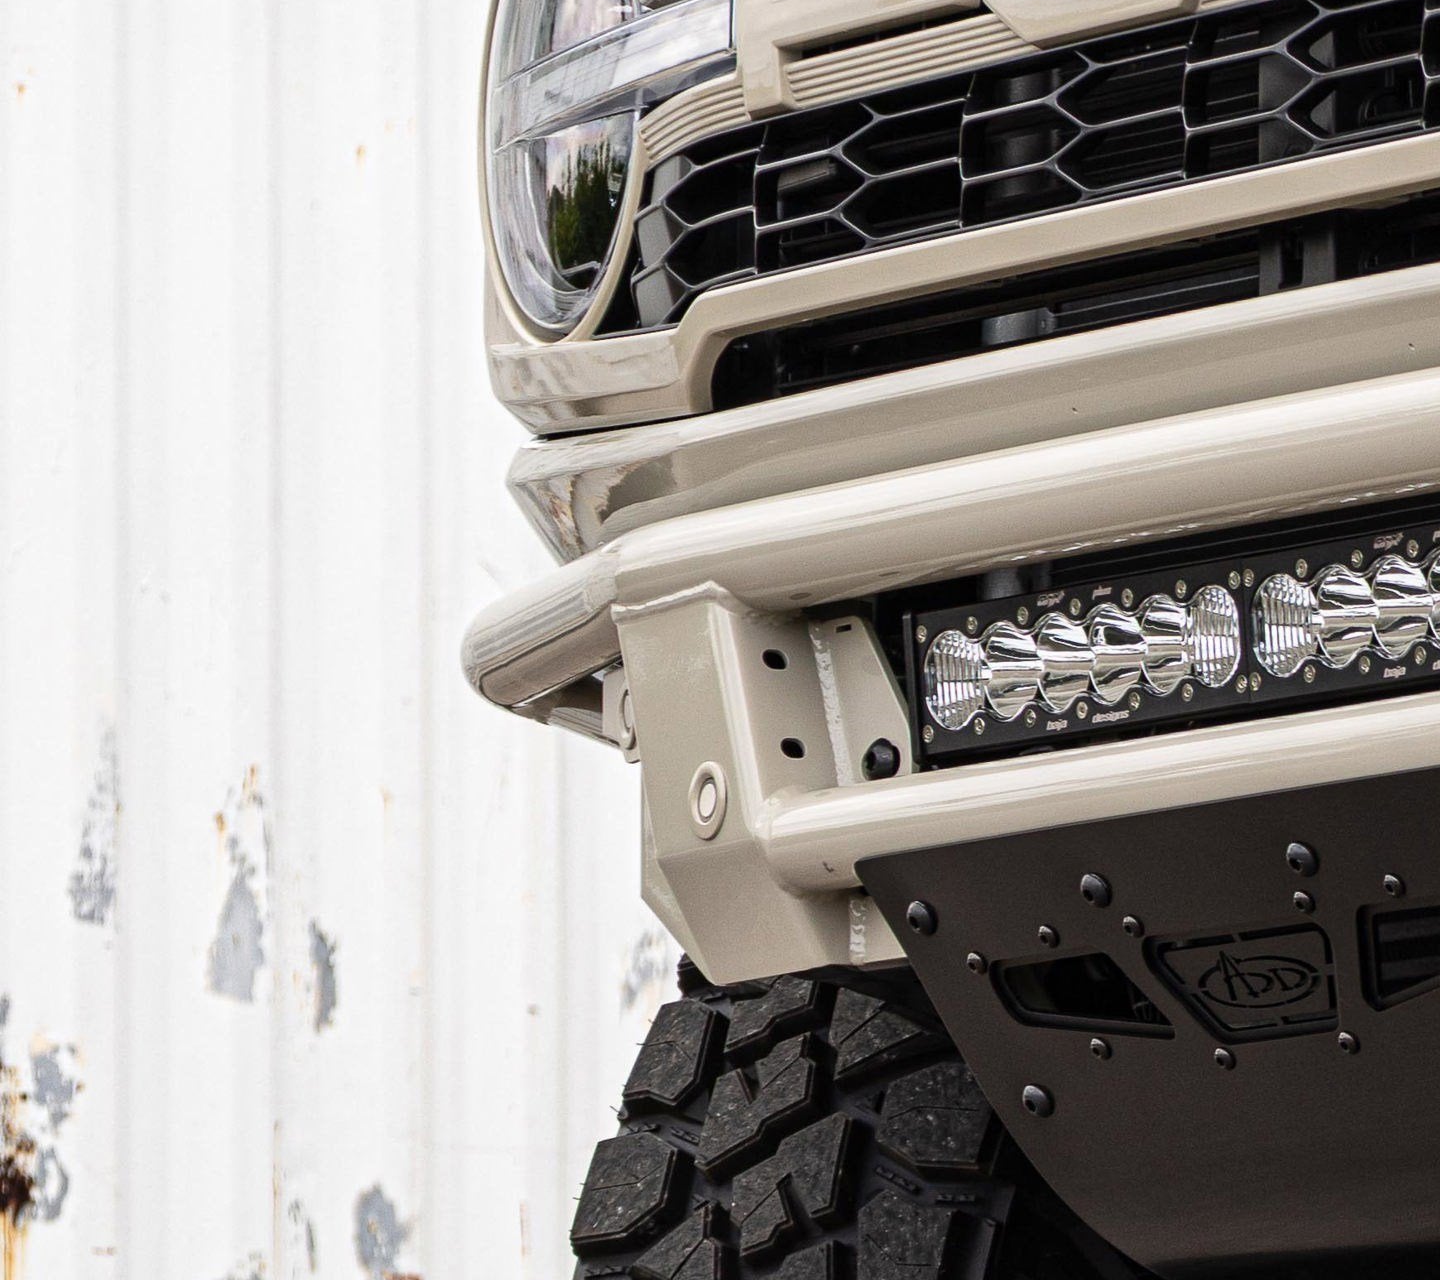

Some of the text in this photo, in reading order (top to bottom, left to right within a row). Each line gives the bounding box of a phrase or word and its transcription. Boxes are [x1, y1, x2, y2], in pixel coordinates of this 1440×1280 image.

[1383, 666, 1406, 678] baja
[1046, 709, 1129, 731] baja designs
